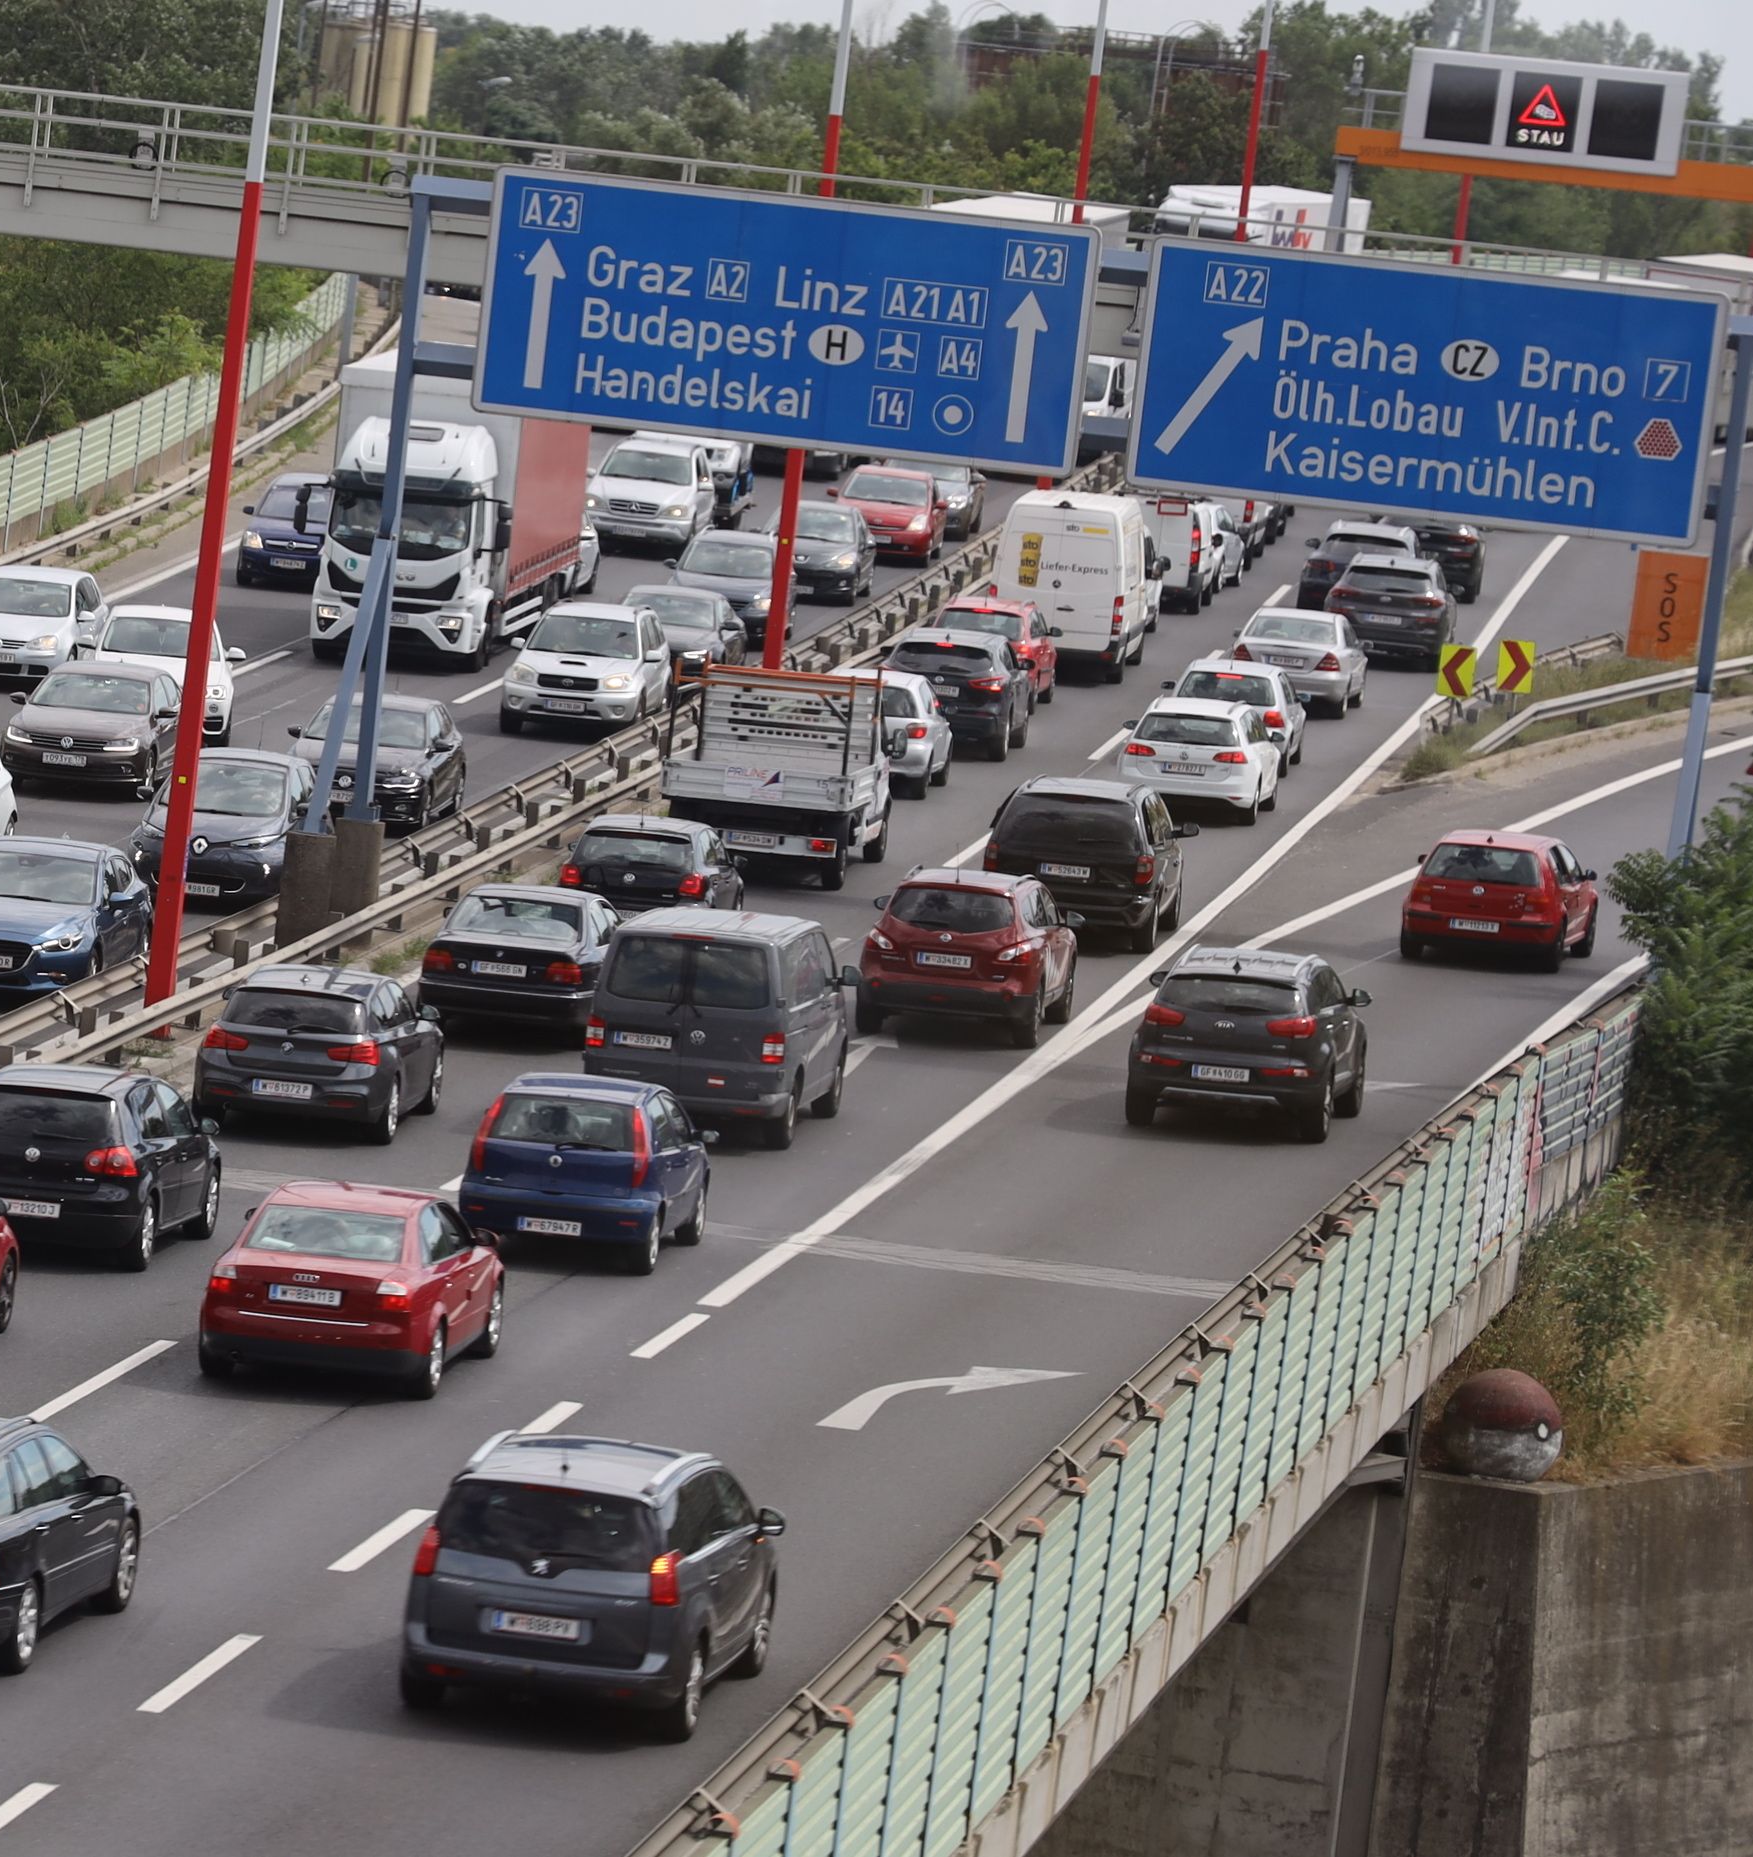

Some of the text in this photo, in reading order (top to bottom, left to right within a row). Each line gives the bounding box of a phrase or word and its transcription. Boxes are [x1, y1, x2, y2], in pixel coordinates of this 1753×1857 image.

[1516, 127, 1565, 147] STAU
[589, 246, 979, 322] Graz A2 Linz A21 A1
[1209, 268, 1264, 302] A22
[582, 298, 975, 374] Budapest H A4
[1280, 320, 1677, 396] Praha CZ Brno 7
[577, 354, 904, 423] Handelskai 14
[1274, 372, 1462, 436] Ölh.Lobau
[1266, 432, 1594, 506] Kaisermühlen
[1022, 540, 1038, 550] sto
[1066, 524, 1080, 532] sto
[1020, 557, 1037, 567] sto
[1041, 561, 1109, 576] Liefer-Express
[1018, 575, 1034, 585] sto
[1657, 572, 1677, 643] SOS
[1200, 1066, 1212, 1076] GF
[1217, 1068, 1233, 1078] 410
